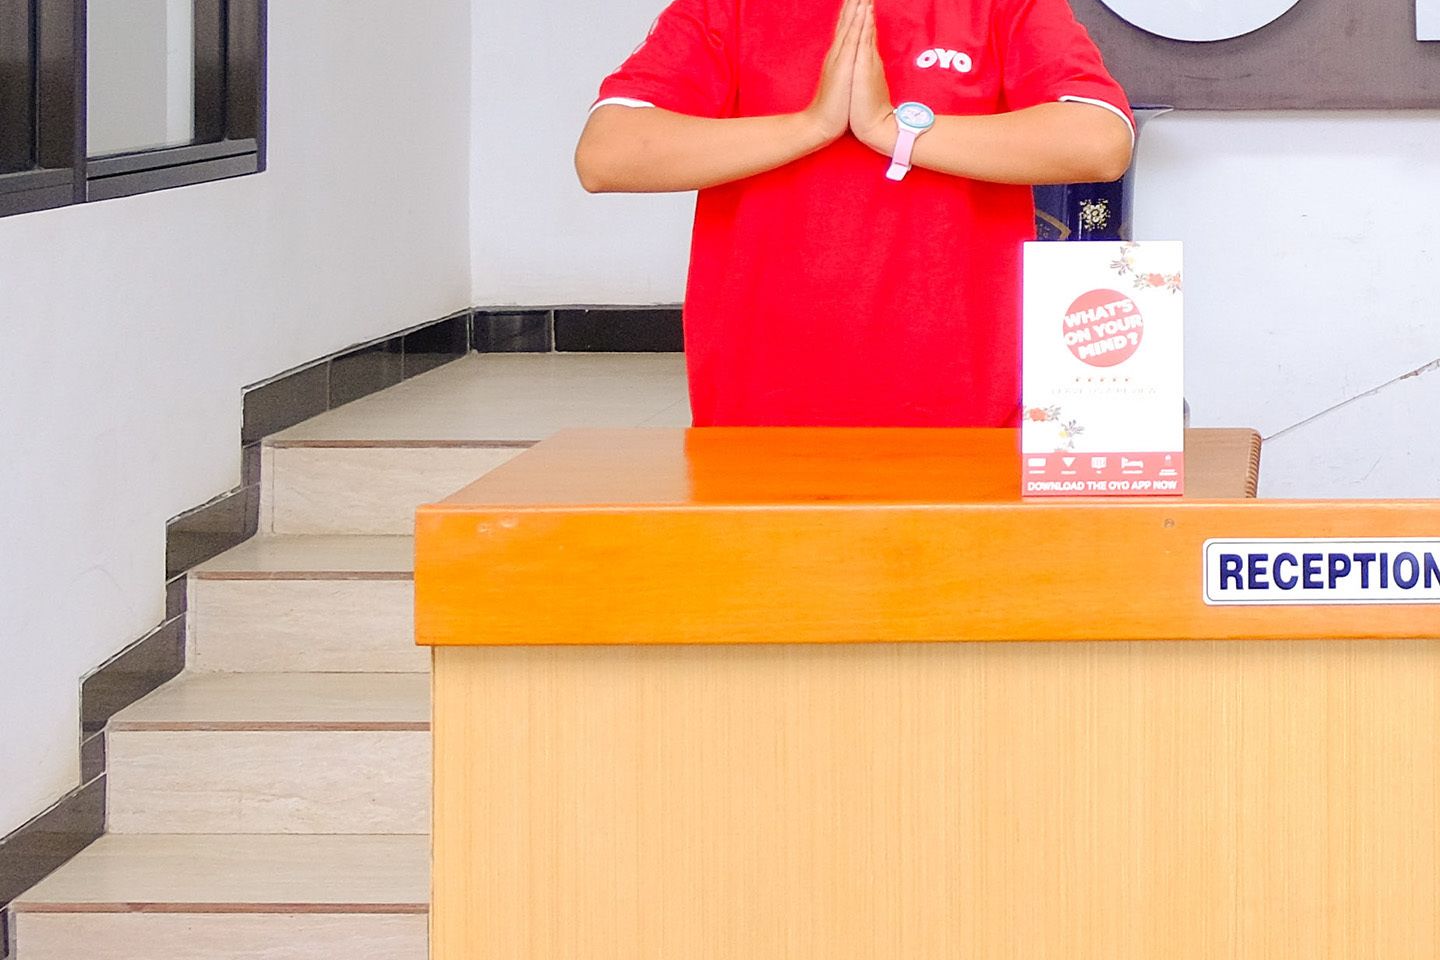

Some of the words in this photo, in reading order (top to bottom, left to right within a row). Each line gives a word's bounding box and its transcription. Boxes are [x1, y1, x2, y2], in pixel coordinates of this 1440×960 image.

[916, 48, 972, 73] OYO
[1064, 299, 1134, 328] WHAT'S
[1064, 328, 1092, 346] ON
[1093, 314, 1143, 338] YOUR
[1027, 481, 1085, 491] DOWNLOAD
[1087, 481, 1107, 490] THE
[1108, 481, 1130, 490] OYO
[1131, 480, 1152, 490] APP
[1153, 480, 1178, 490] NOW
